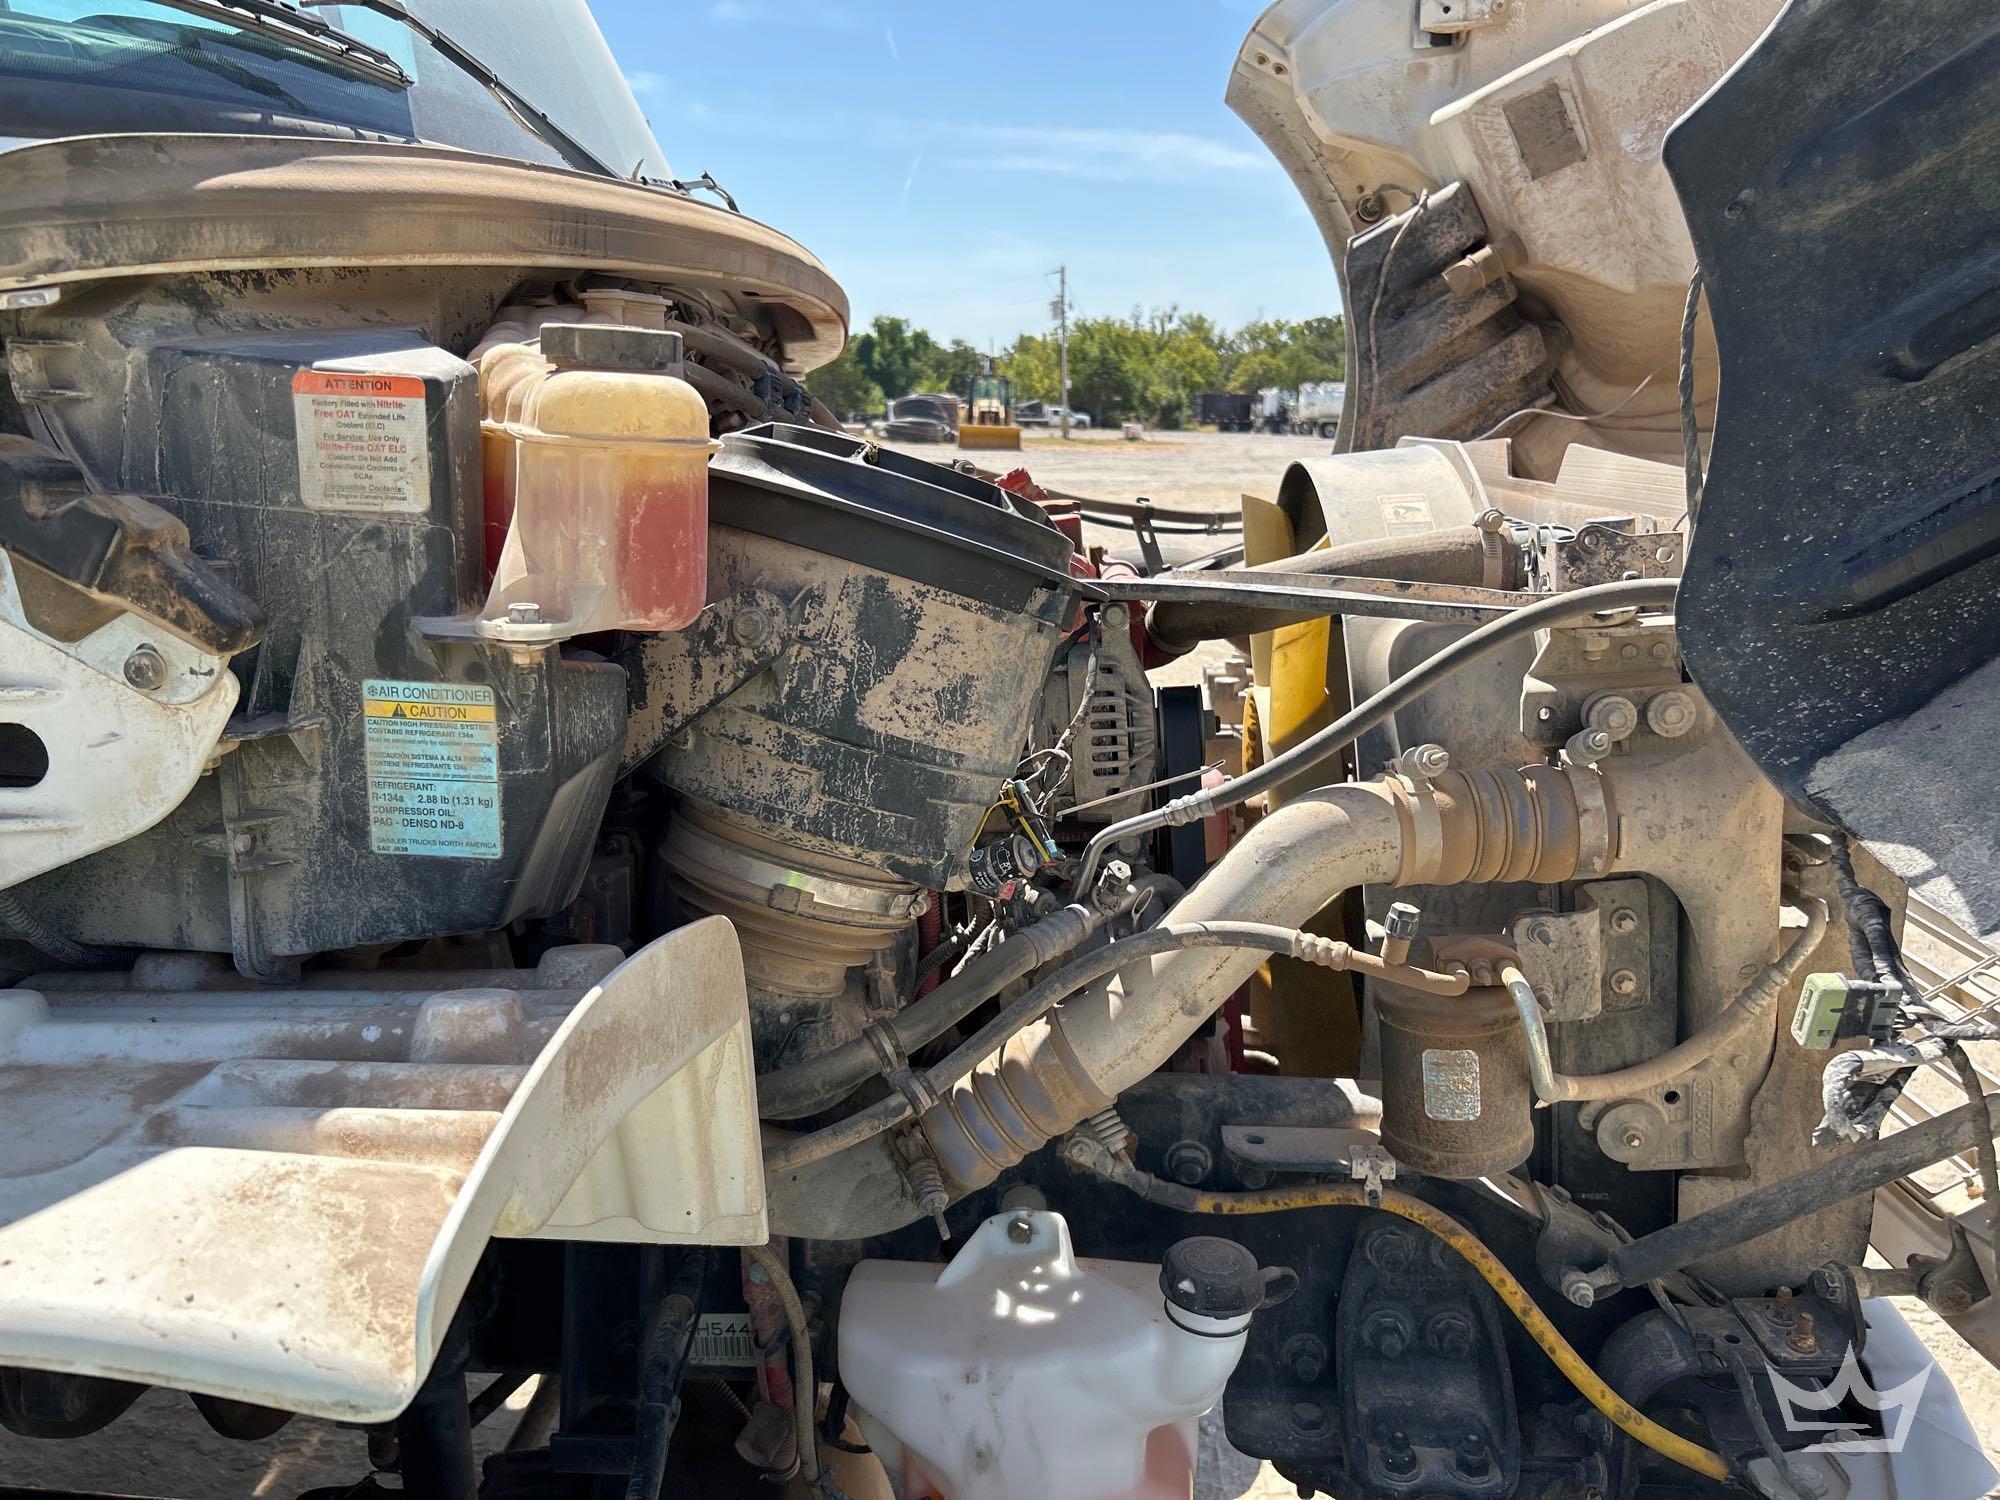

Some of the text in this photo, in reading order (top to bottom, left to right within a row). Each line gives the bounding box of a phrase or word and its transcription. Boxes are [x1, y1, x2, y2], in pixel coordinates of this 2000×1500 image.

[326, 380, 392, 390] ATTENTION
[312, 399, 406, 409] Factory Filled with Nitrite-
[314, 409, 405, 421] Free OAT Extended Life
[384, 435, 400, 443] Only
[368, 444, 386, 452] OAT
[389, 445, 407, 454] ELC
[379, 686, 491, 702] AIR CONDITIONER
[410, 705, 467, 719] CAUTION
[368, 719, 399, 727] CAUTION
[420, 722, 458, 730] PRESSURE
[369, 728, 403, 736] CONTAINS
[405, 729, 456, 738] REFRIGERANT
[403, 762, 452, 770] REFRIGERANTE
[371, 781, 437, 792] REFRIGERANT:
[372, 792, 493, 808] R-134a 2.88 lb (1.31 kg)
[373, 805, 455, 817] COMPRESSOR OIL:
[373, 817, 393, 827] PAG
[402, 818, 438, 828] DENSO
[441, 819, 464, 829] ND-8
[377, 837, 407, 845] DAIMLER
[409, 838, 437, 846] TRUCKS
[465, 841, 497, 849] AMERICA
